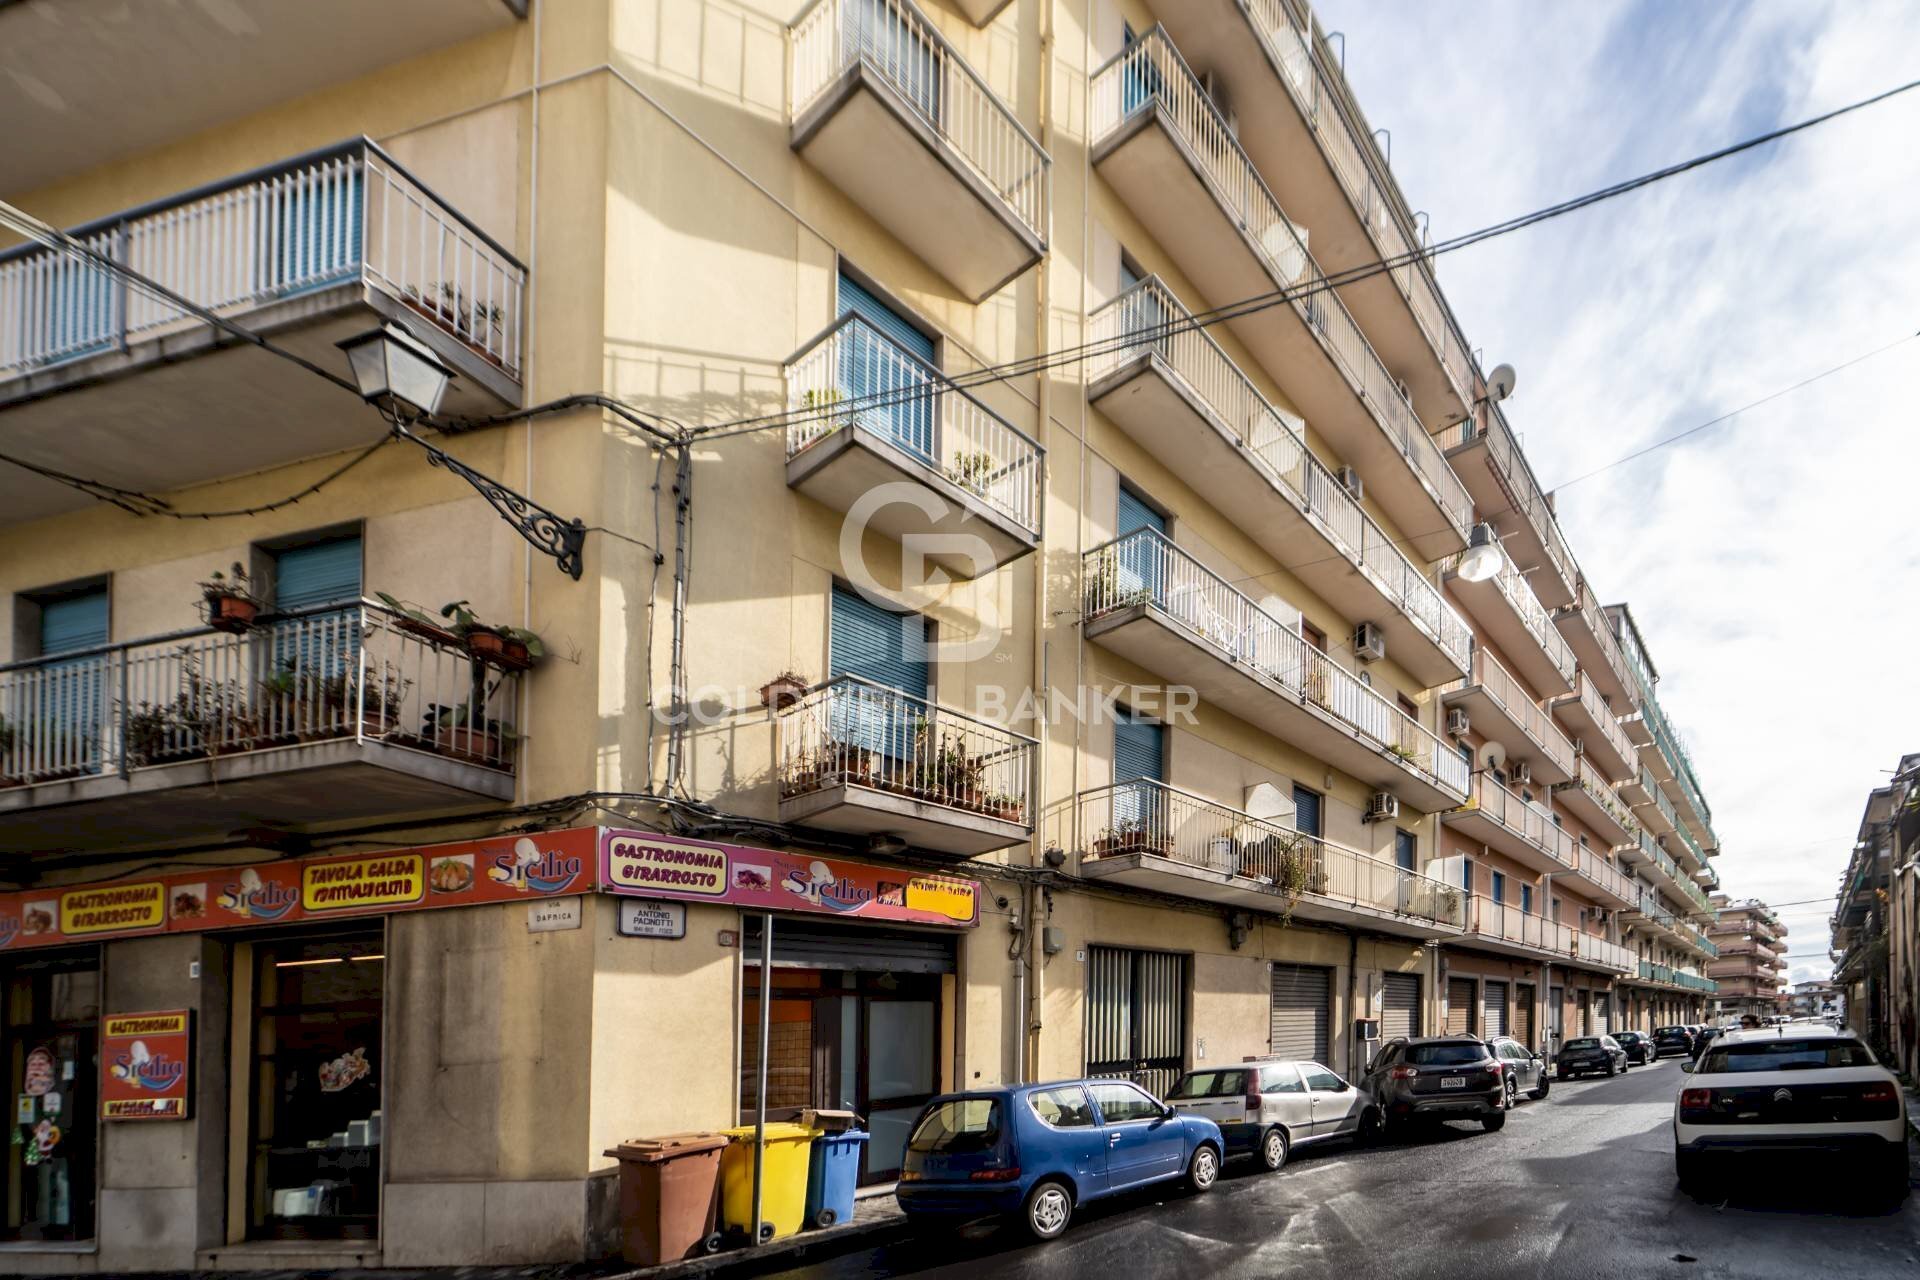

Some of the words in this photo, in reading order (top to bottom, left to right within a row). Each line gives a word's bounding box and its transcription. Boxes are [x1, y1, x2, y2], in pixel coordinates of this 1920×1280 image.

[495, 850, 582, 882] Sicilia
[613, 842, 724, 870] GASTRONOMIA
[310, 862, 363, 886] TAVOLA
[367, 858, 416, 878] CALDA
[622, 864, 717, 888] GIRARROSTO
[222, 879, 299, 909] Sicilia
[788, 870, 872, 901] Sicilia
[66, 886, 159, 911] GASTRONOMIA
[647, 903, 662, 911] VIA
[72, 905, 153, 928] GIRARROSTO
[633, 917, 674, 927] PACINOTTI
[637, 910, 671, 920] ANTONIO
[115, 1054, 182, 1079] Sicilia
